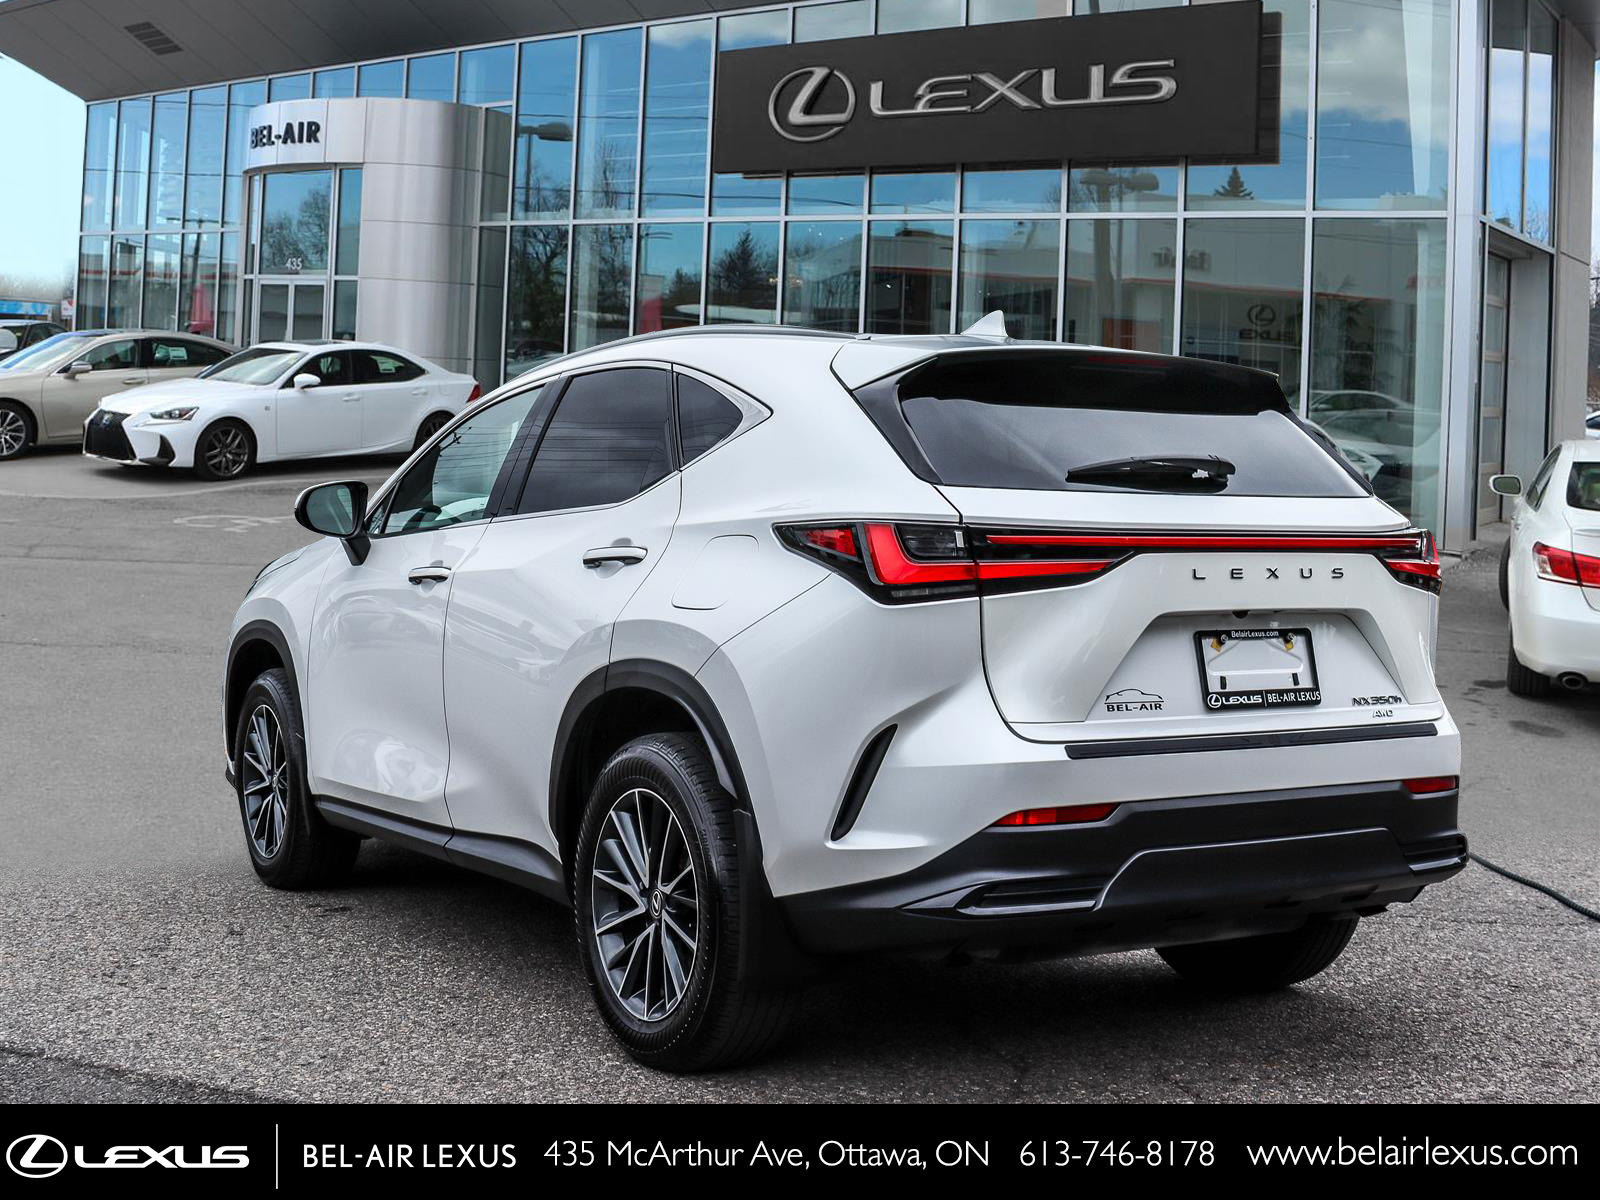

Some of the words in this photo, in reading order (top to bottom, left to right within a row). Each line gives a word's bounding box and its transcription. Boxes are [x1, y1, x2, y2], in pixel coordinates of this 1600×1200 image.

[869, 58, 1178, 118] LEXUS
[250, 121, 321, 149] BEL-AIR
[286, 257, 302, 270] 435
[1193, 567, 1344, 581] LEXUS
[1231, 630, 1279, 638] BelairLexus.com
[1222, 695, 1262, 705] LEXUS
[1267, 692, 1295, 703] BEL-AIR
[1297, 690, 1321, 702] LEXUS
[1106, 703, 1163, 712] BEL-AIR
[1373, 709, 1393, 718] AWD
